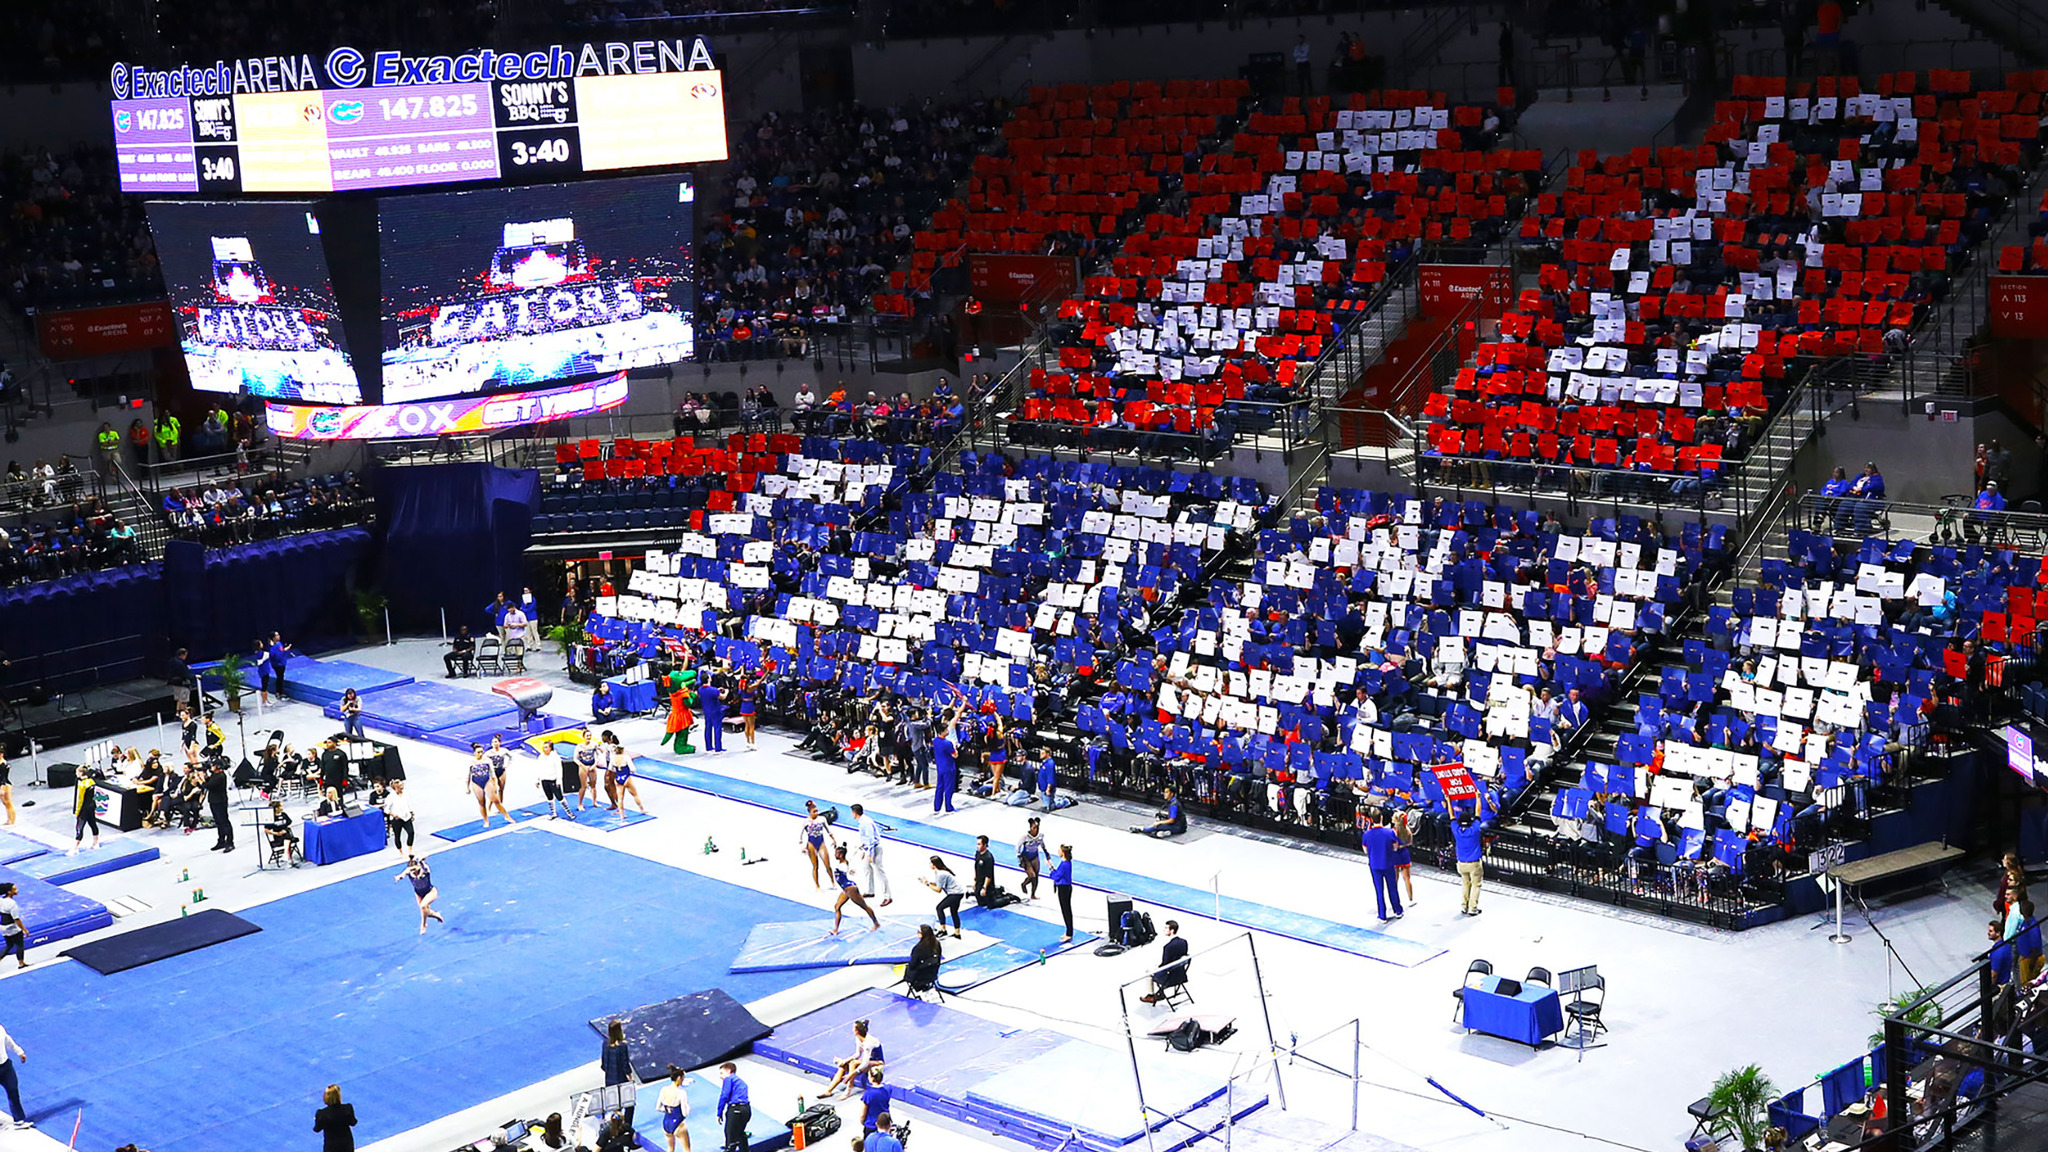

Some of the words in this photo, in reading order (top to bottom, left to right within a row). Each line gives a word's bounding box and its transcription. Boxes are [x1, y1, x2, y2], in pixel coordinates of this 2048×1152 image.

[372, 45, 575, 87] Exactech
[576, 38, 716, 77] ARENA
[131, 60, 232, 99] Exactech
[233, 54, 319, 94] ARENA
[501, 80, 569, 106] SONNY'S
[377, 93, 478, 121] 147.825
[508, 104, 540, 122] BBQ
[136, 108, 184, 131] 147.825
[330, 147, 370, 160] VAULT
[417, 142, 451, 154] BARS
[511, 138, 570, 166] 3:40
[202, 156, 235, 181] 3:40
[333, 168, 371, 181] BEAM
[416, 162, 458, 174] FLOOR
[461, 159, 495, 171] 0.000
[2014, 294, 2027, 303] 113
[2014, 312, 2025, 321] 13
